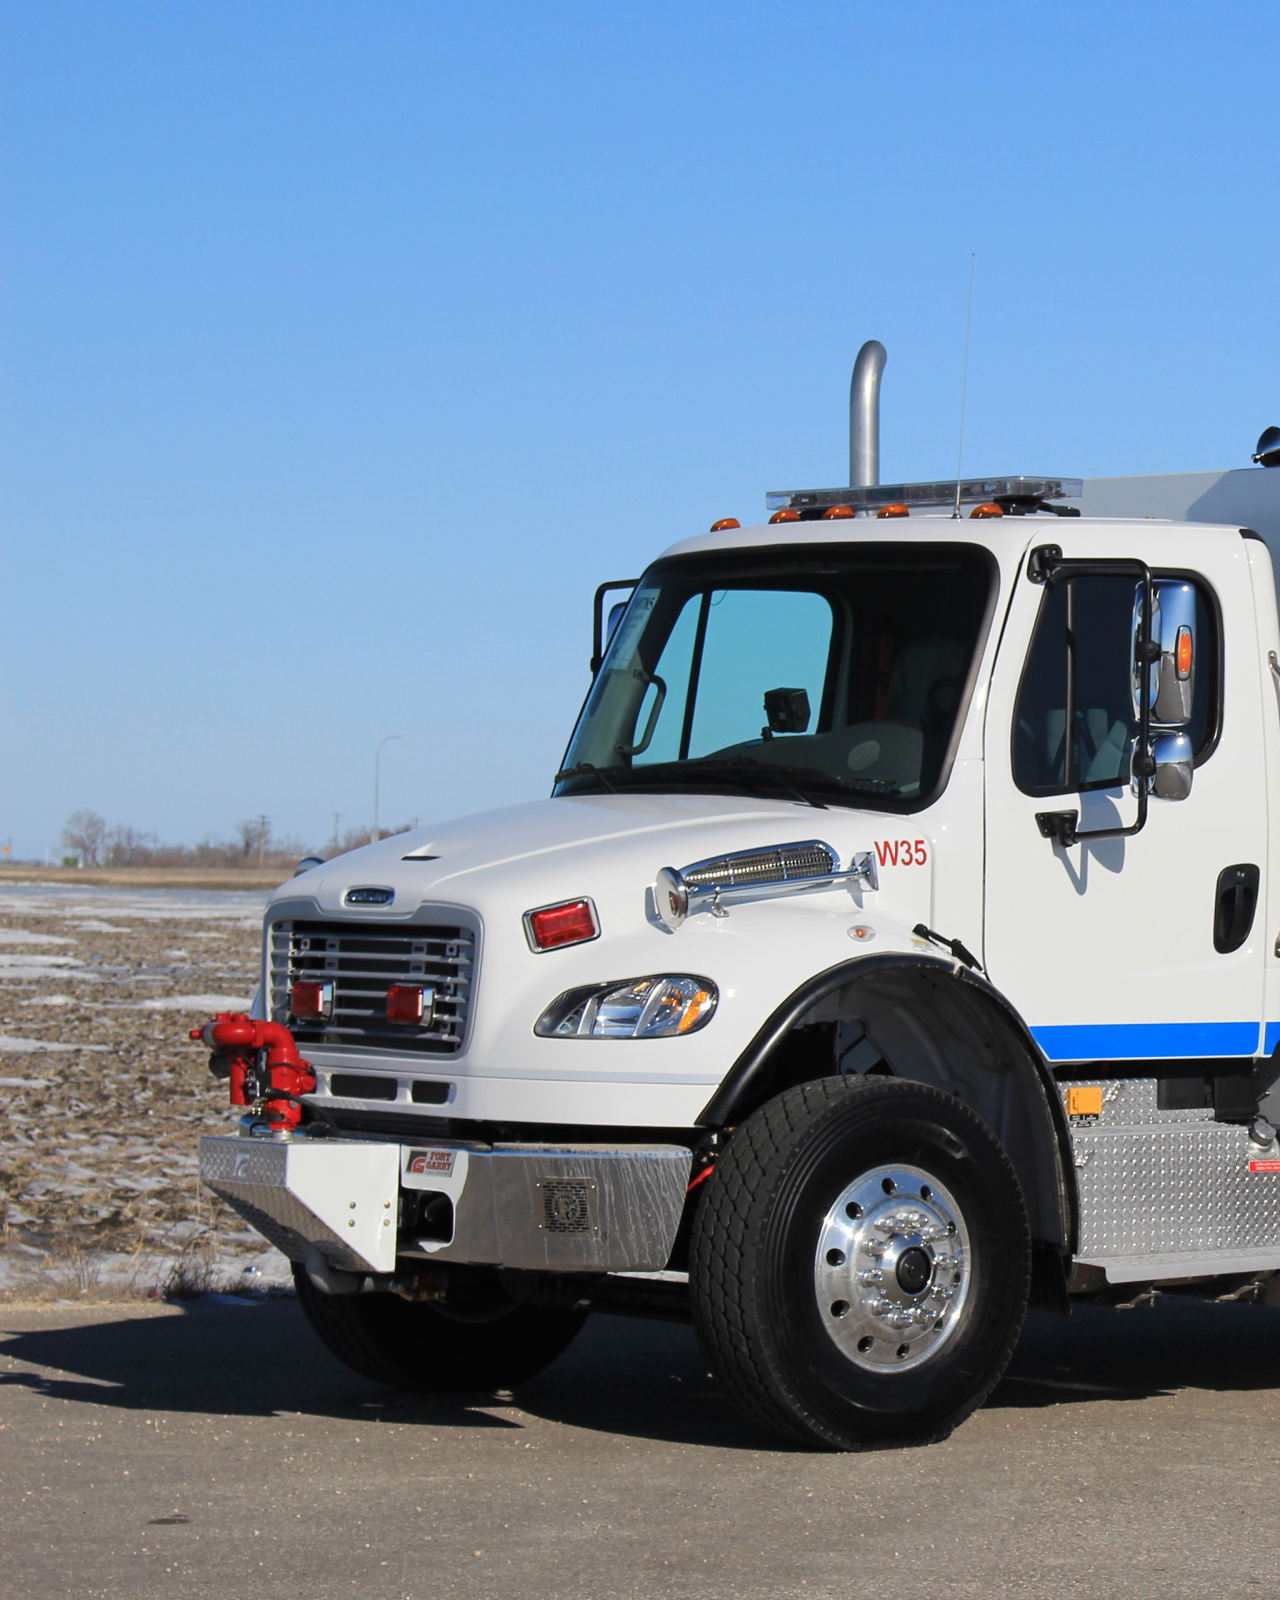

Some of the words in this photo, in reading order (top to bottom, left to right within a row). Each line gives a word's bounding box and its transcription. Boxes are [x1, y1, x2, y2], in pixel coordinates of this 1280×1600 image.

[874, 840, 927, 867] W35
[430, 1151, 452, 1161] FORT
[426, 1161, 452, 1171] GARRY
